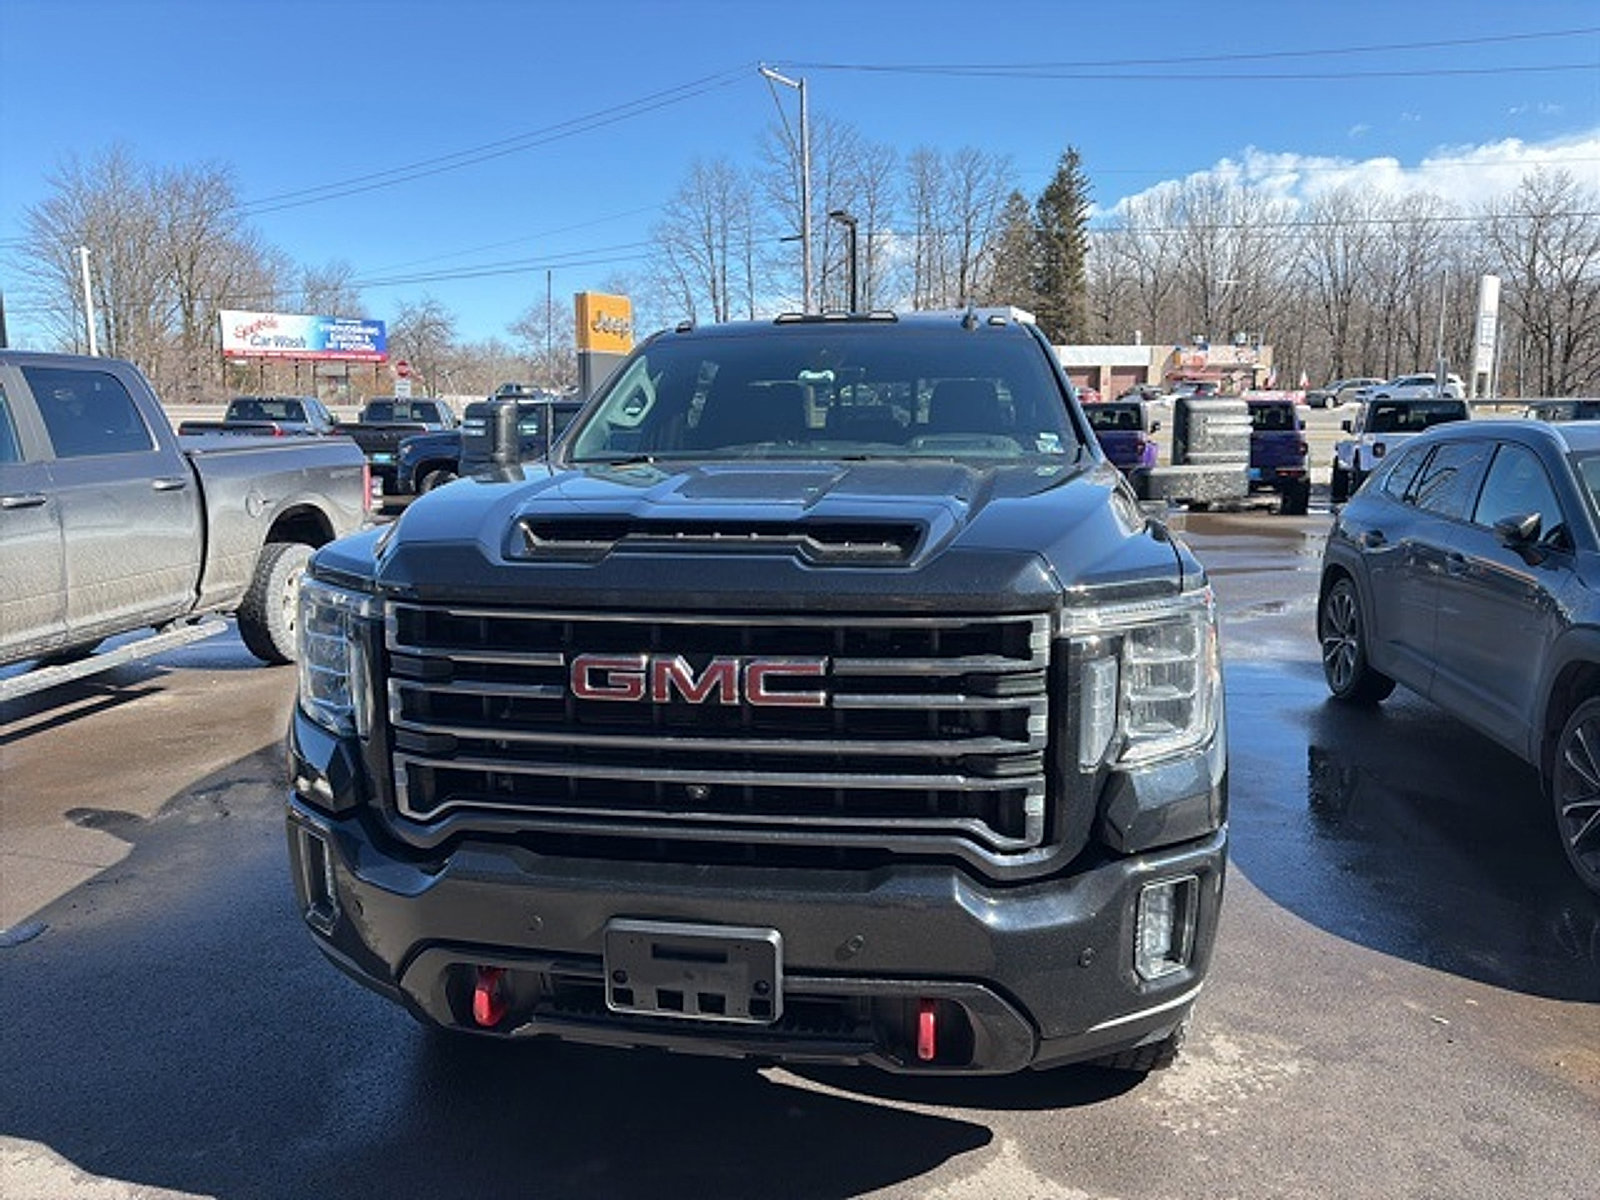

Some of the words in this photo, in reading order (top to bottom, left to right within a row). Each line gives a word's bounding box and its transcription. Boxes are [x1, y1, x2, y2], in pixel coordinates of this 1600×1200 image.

[591, 310, 630, 339] Jeep
[250, 334, 271, 347] Car
[273, 335, 307, 349] Wash
[570, 653, 828, 707] GMC
